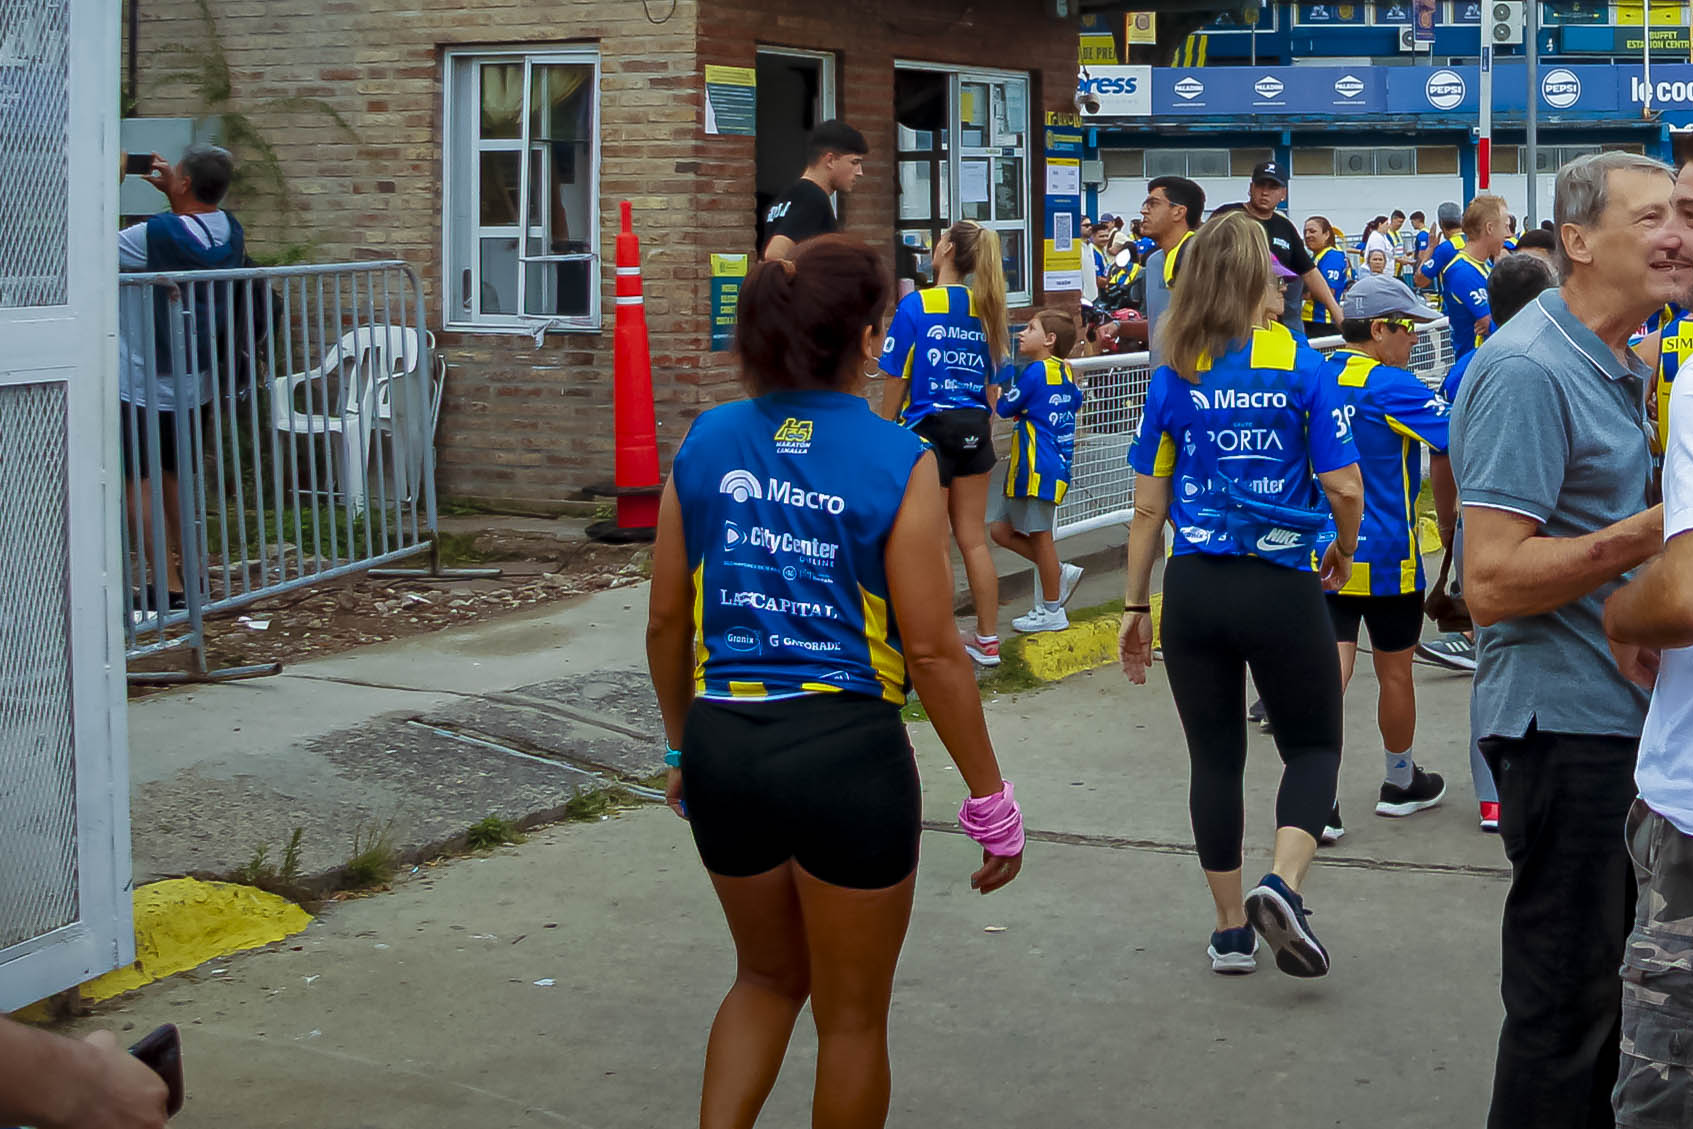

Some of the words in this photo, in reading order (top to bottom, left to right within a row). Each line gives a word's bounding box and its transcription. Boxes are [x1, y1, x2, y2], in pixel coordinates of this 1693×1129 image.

[1429, 85, 1462, 94] PEPSI
[1545, 83, 1577, 93] PEPSI
[1214, 388, 1287, 409] Macro
[766, 478, 845, 515] Macro
[1266, 527, 1302, 544] NIKE
